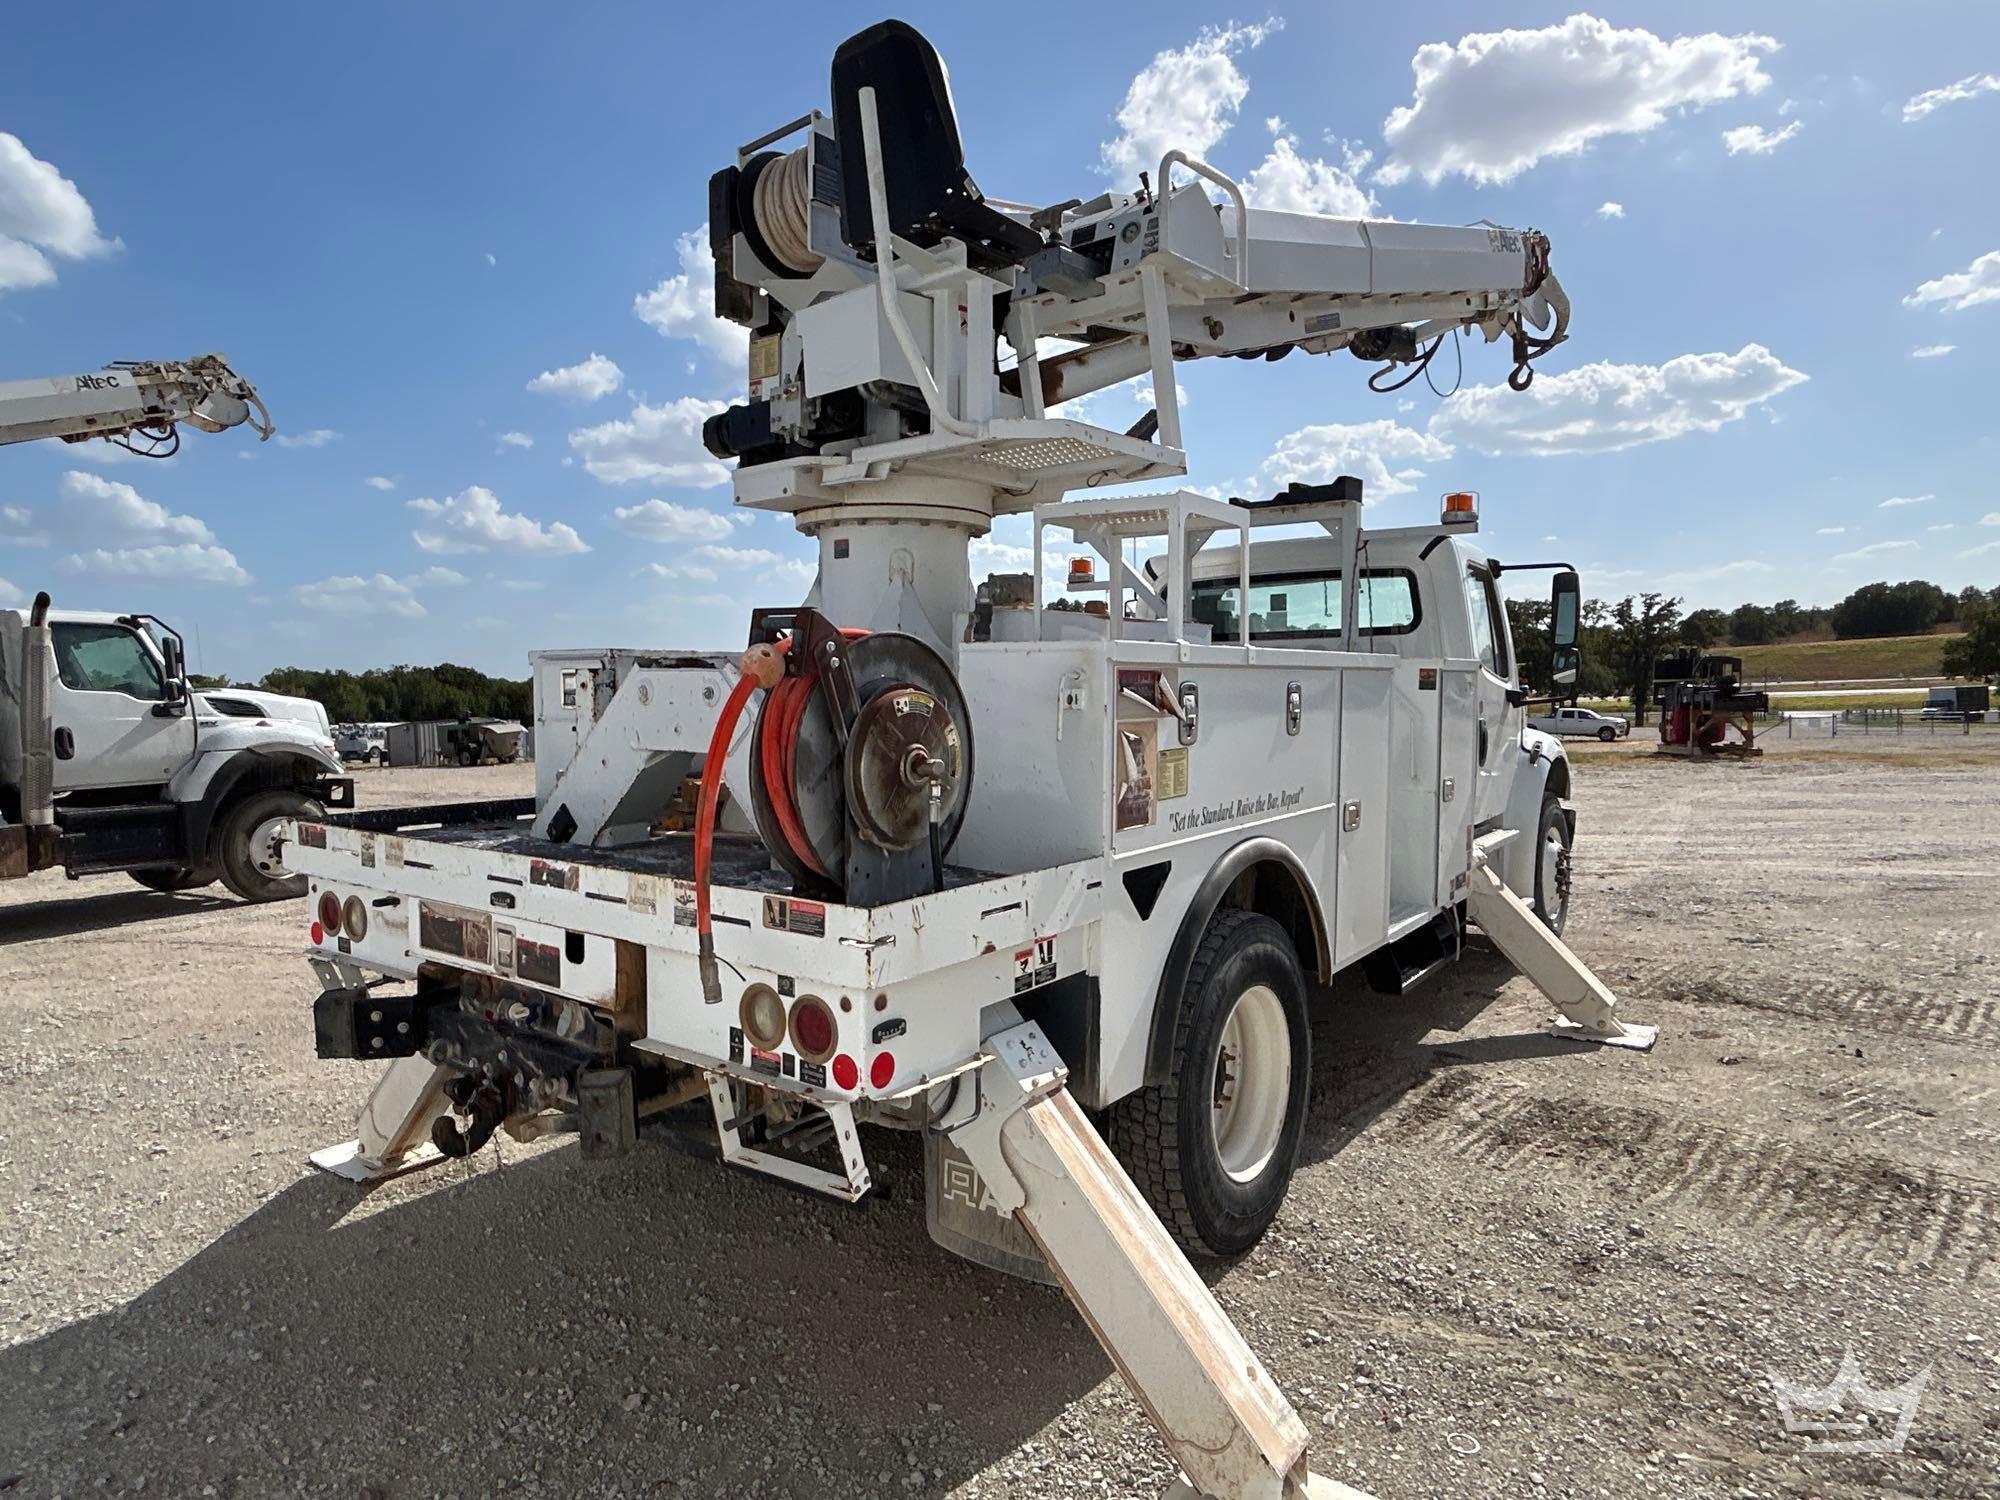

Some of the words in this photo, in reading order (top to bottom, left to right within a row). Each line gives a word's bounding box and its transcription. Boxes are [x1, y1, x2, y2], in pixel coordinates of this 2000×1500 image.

[75, 375, 119, 391] Altec
[1187, 808, 1200, 829] the
[1201, 800, 1234, 826] Standard,
[1236, 797, 1255, 818] Raise
[1255, 795, 1266, 813] the
